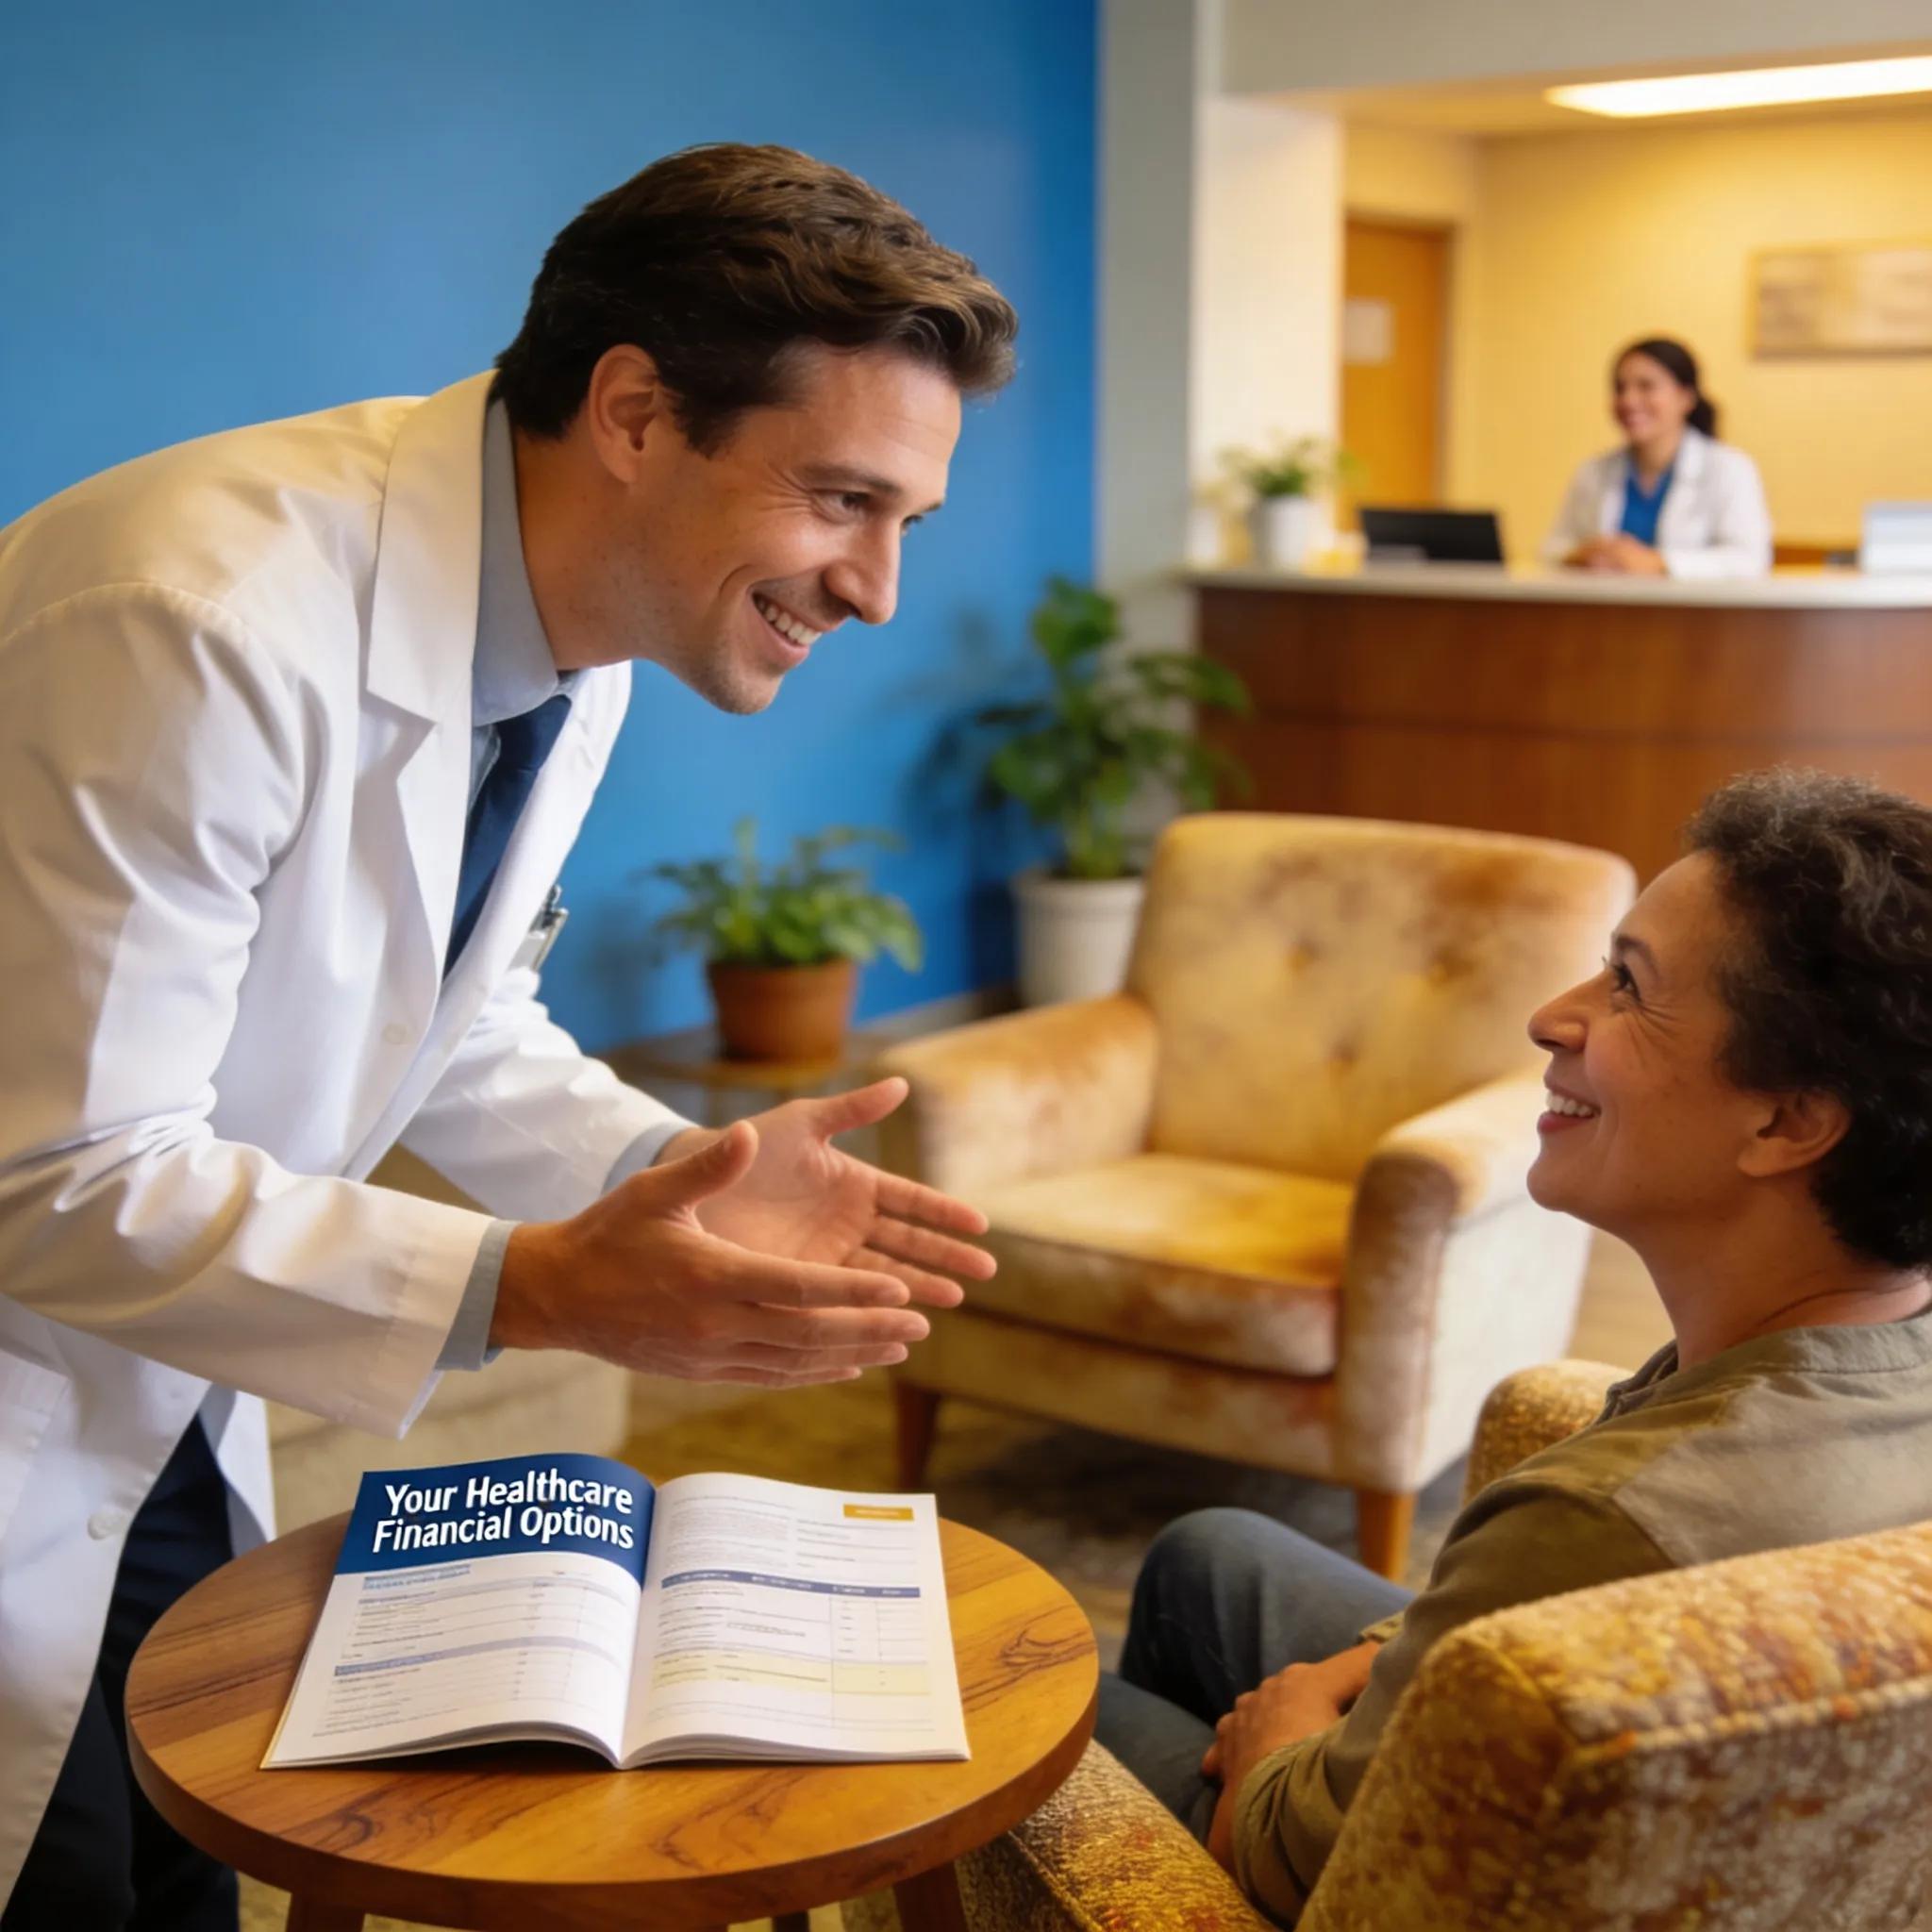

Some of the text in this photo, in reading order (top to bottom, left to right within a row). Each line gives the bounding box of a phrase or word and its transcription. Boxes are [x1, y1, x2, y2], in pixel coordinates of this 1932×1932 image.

[385, 1468, 633, 1516] Your Healthcare
[373, 1507, 512, 1553] Financial
[520, 1506, 634, 1549] Options
